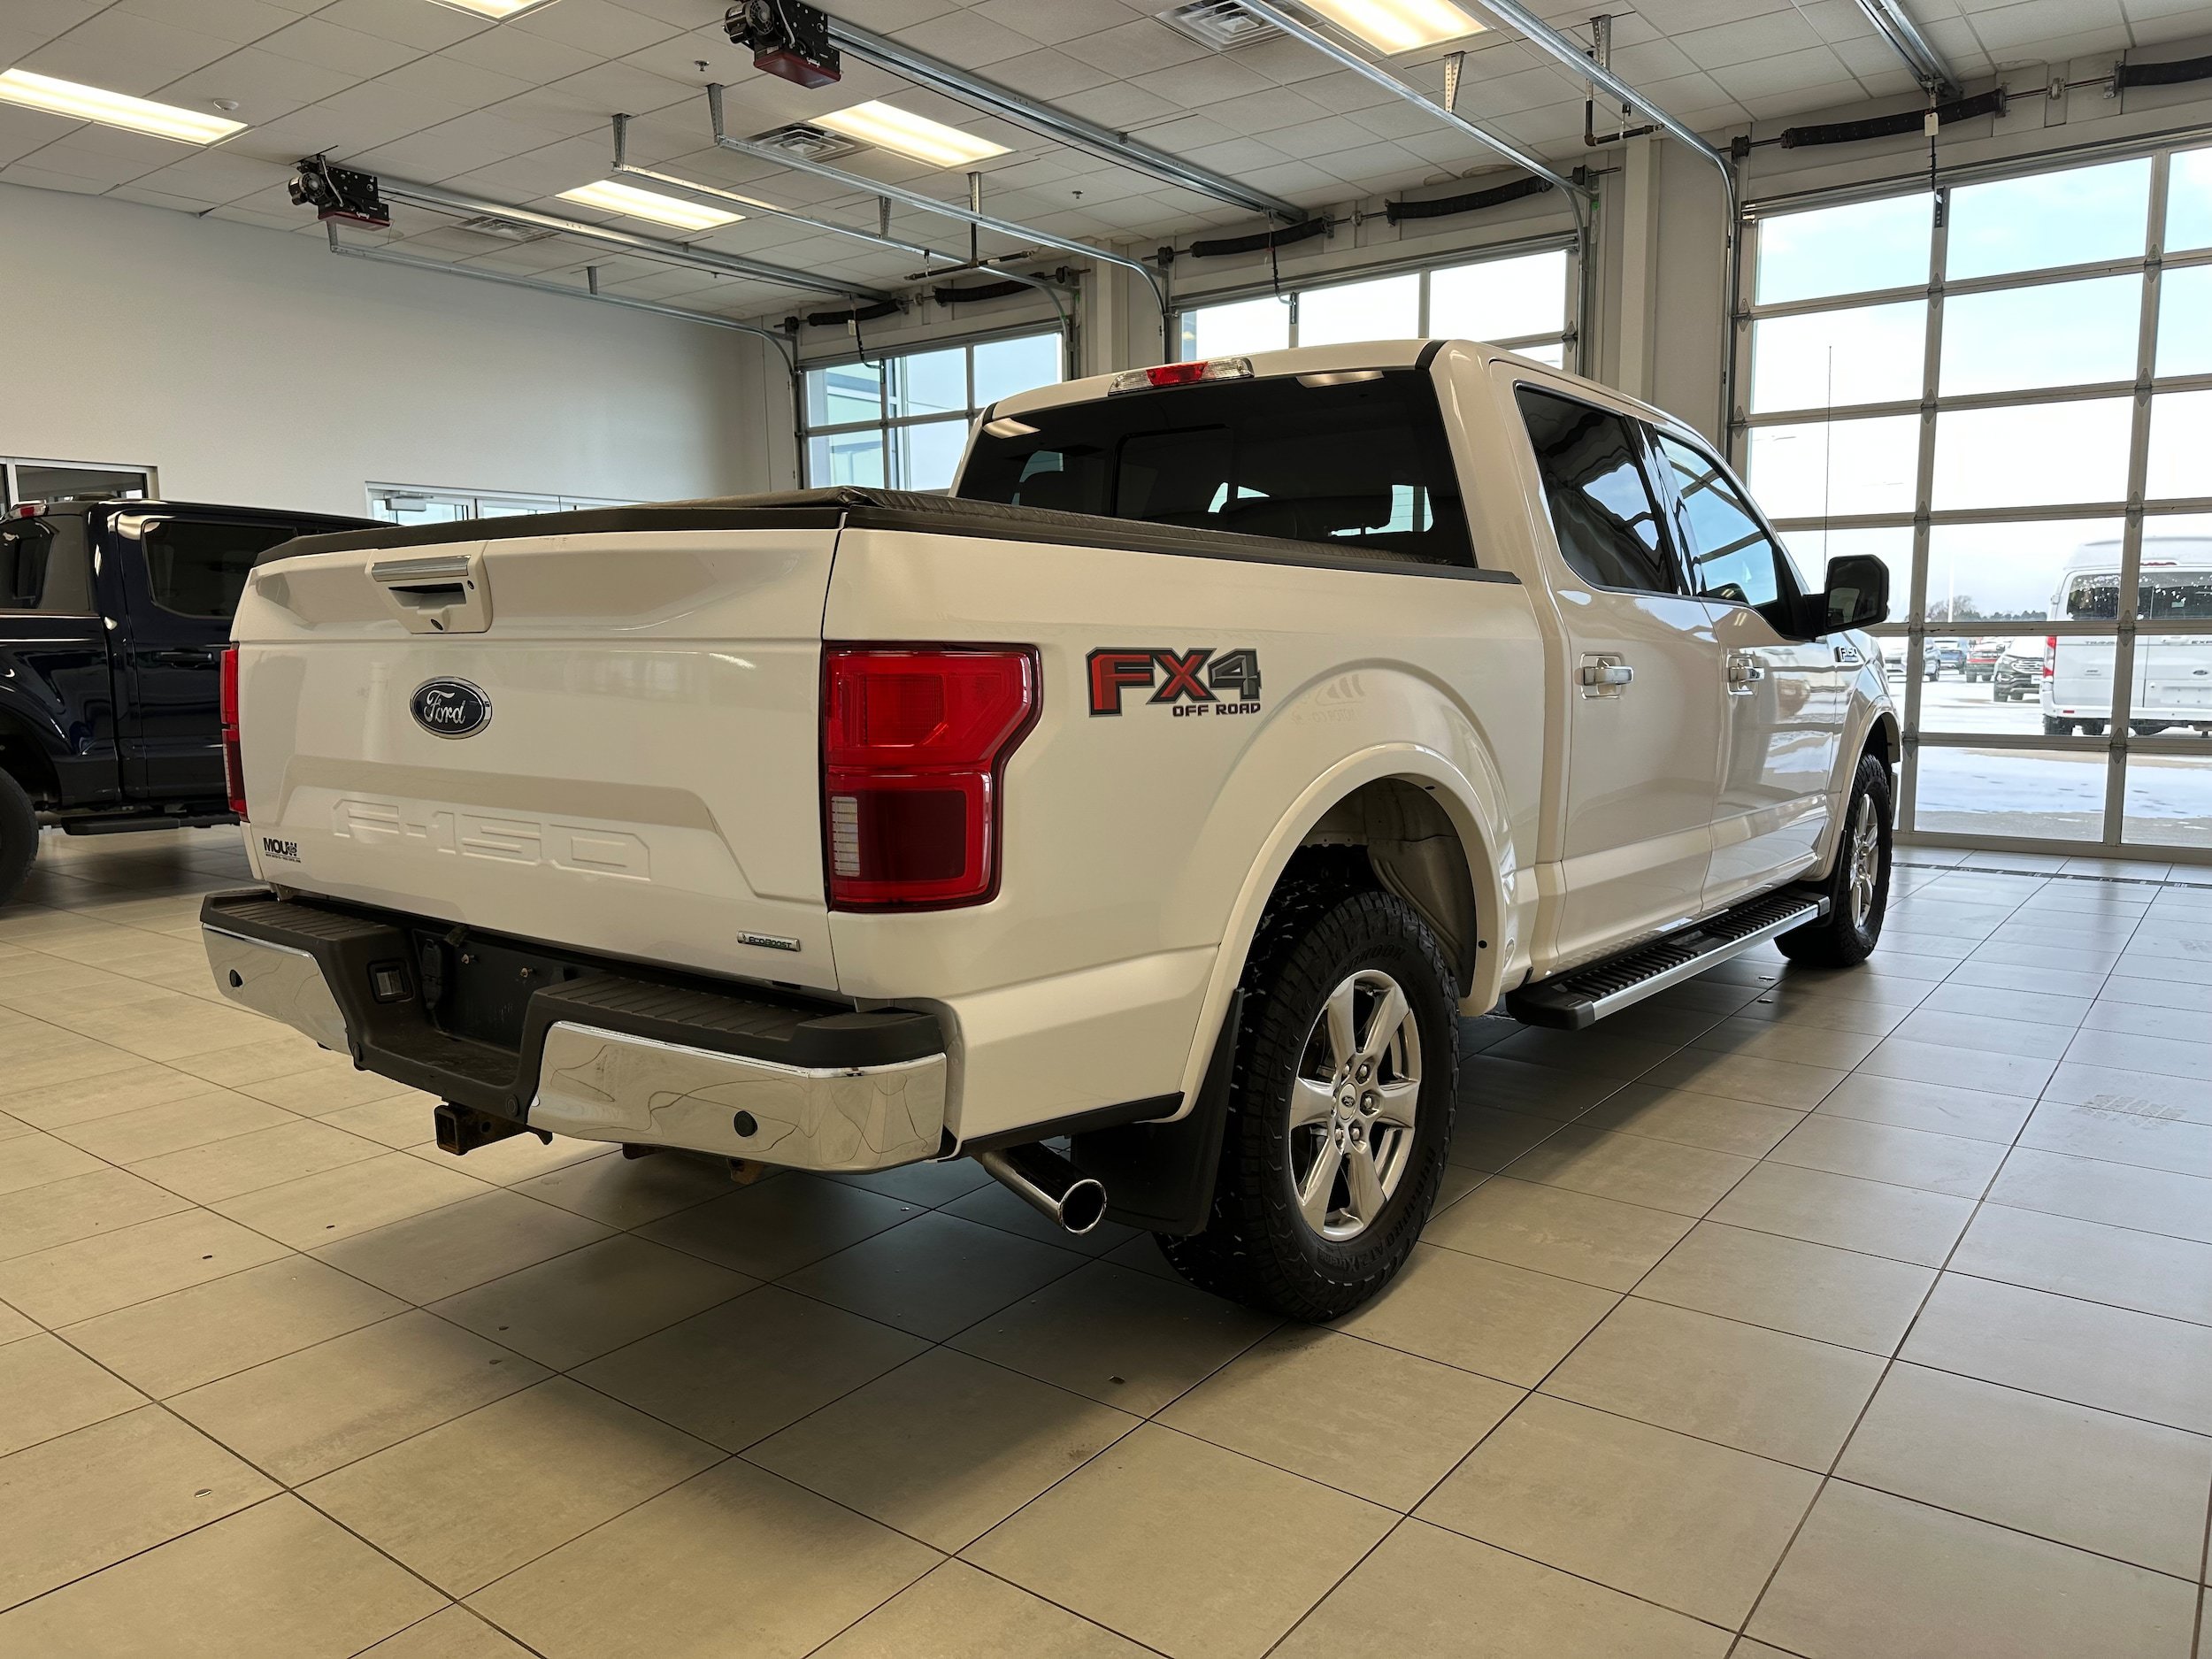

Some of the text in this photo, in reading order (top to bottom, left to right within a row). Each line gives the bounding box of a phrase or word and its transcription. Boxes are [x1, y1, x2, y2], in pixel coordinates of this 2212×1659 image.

[424, 689, 466, 724] Ford
[1086, 647, 1262, 718] FX4
[1171, 703, 1261, 718] OFF ROAD
[332, 798, 650, 882] F-150
